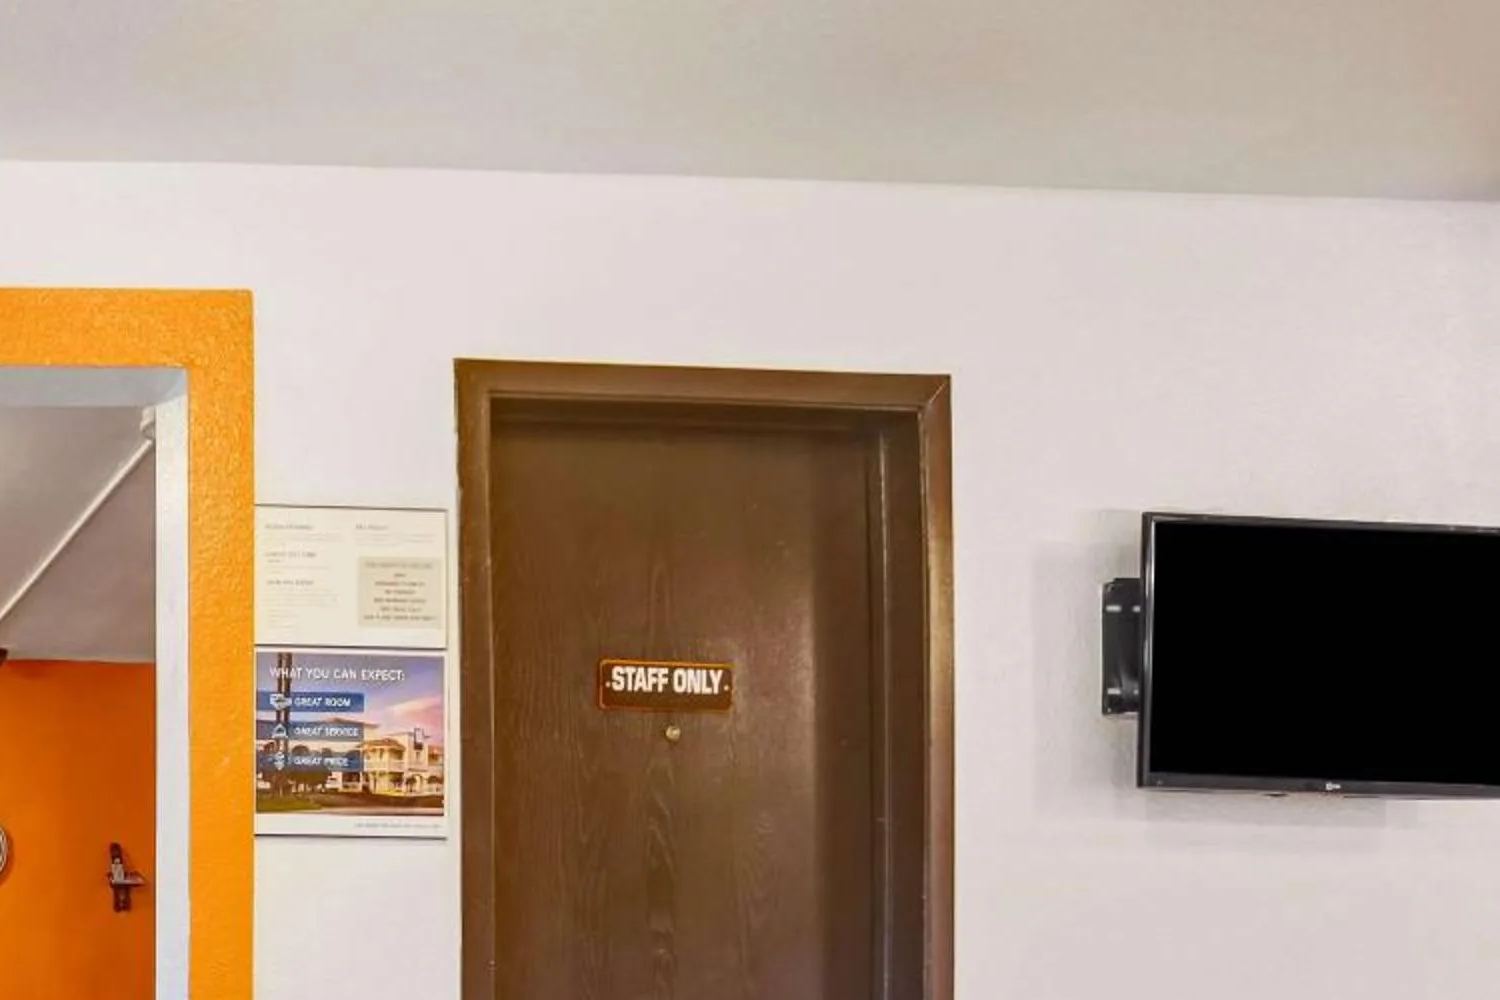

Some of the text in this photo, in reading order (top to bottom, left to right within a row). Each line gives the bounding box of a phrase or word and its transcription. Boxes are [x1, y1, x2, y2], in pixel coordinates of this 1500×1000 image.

[269, 666, 406, 681] WHAT YOU CAN EXPECT:
[611, 665, 723, 695] STAFF ONLY
[294, 697, 352, 707] GREAT ROOM
[294, 726, 359, 737] GREAT SERVICE
[293, 756, 322, 766] GREAT
